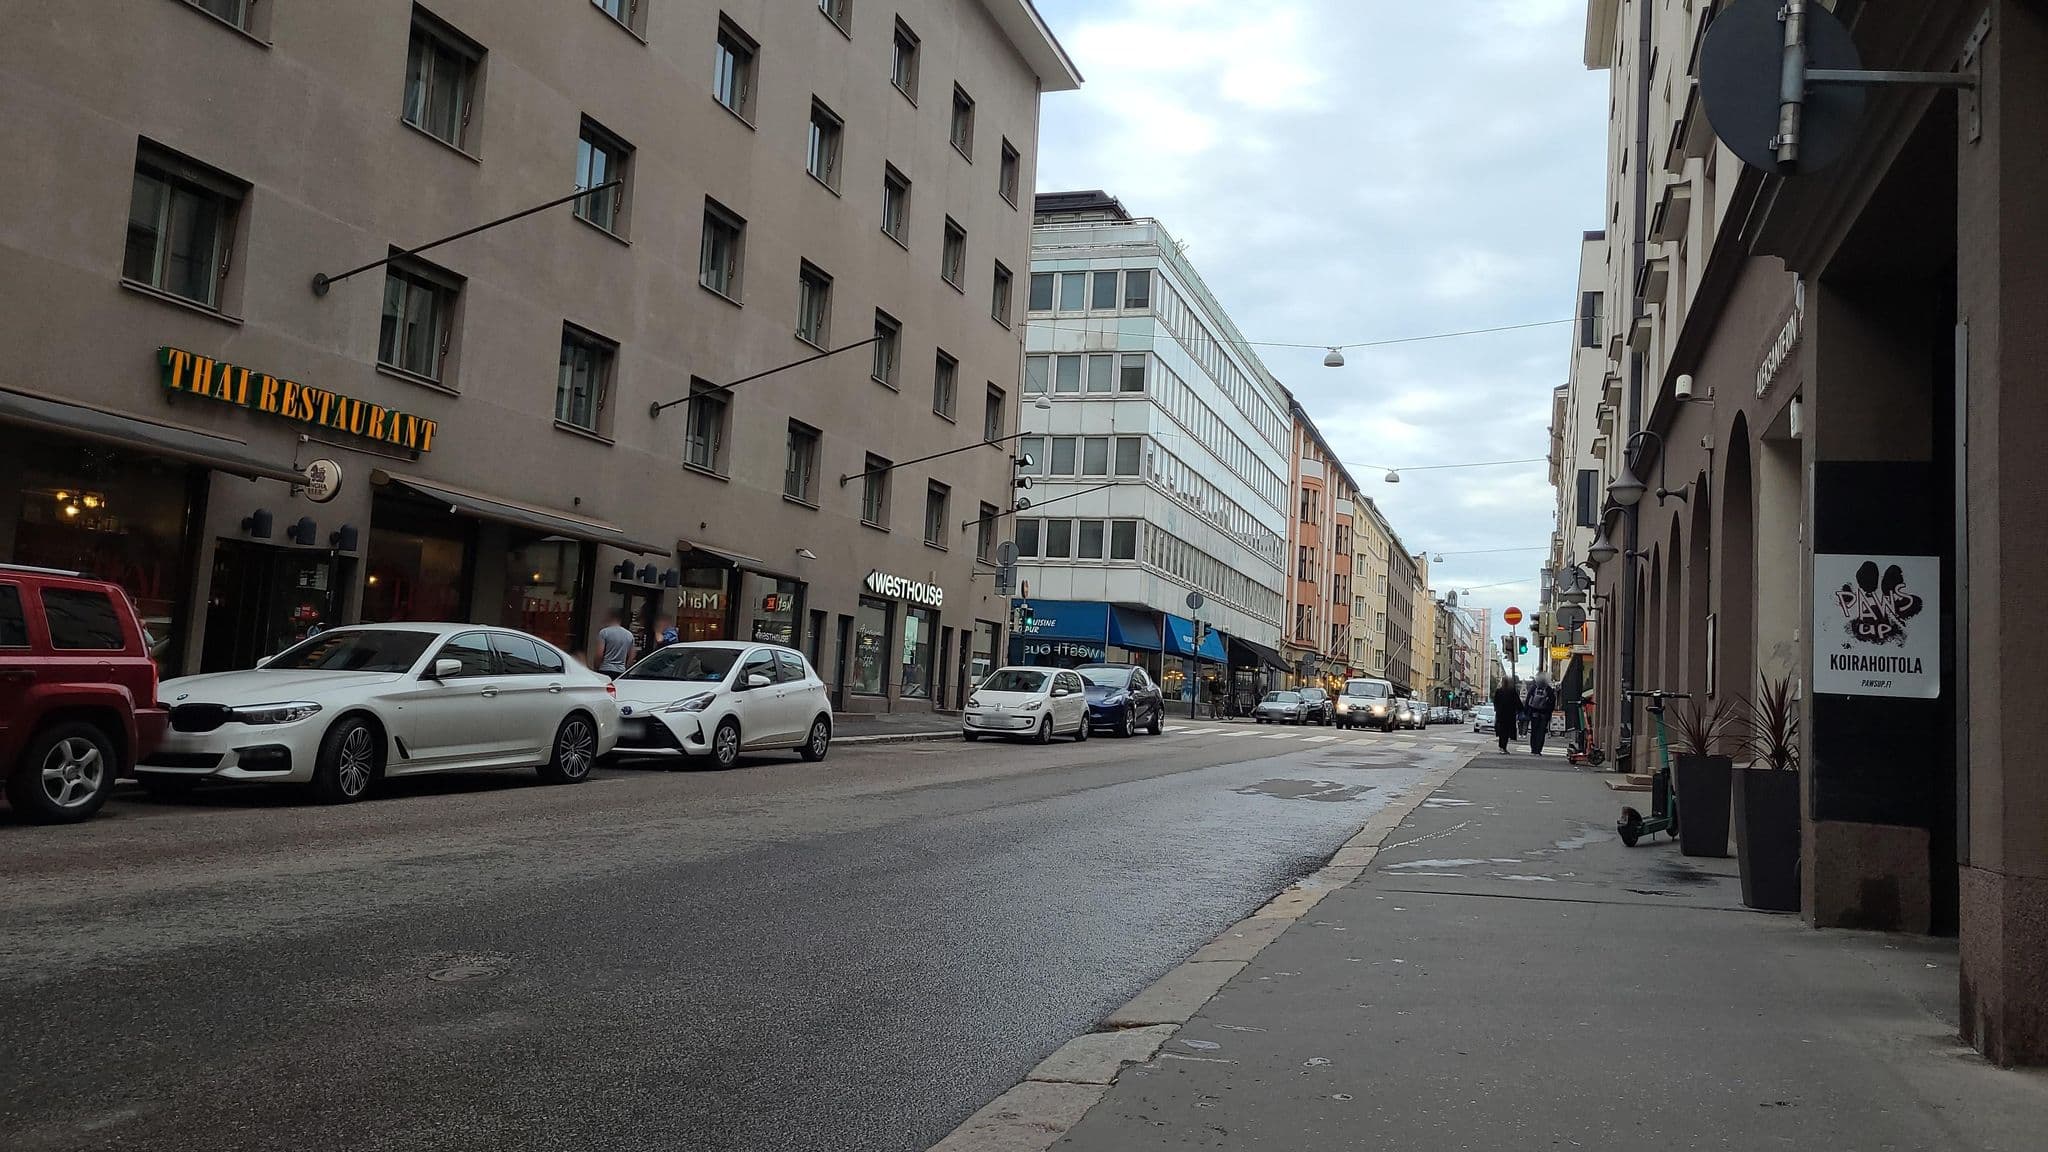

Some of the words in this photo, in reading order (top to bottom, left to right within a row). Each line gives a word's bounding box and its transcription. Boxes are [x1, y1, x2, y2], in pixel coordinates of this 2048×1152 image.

[167, 348, 252, 405] THAI
[260, 375, 438, 453] RESTAURANT
[1836, 583, 1914, 621] PAWS
[1032, 618, 1057, 627] UISINE
[1830, 654, 1923, 674] KOIRAHOITOLA
